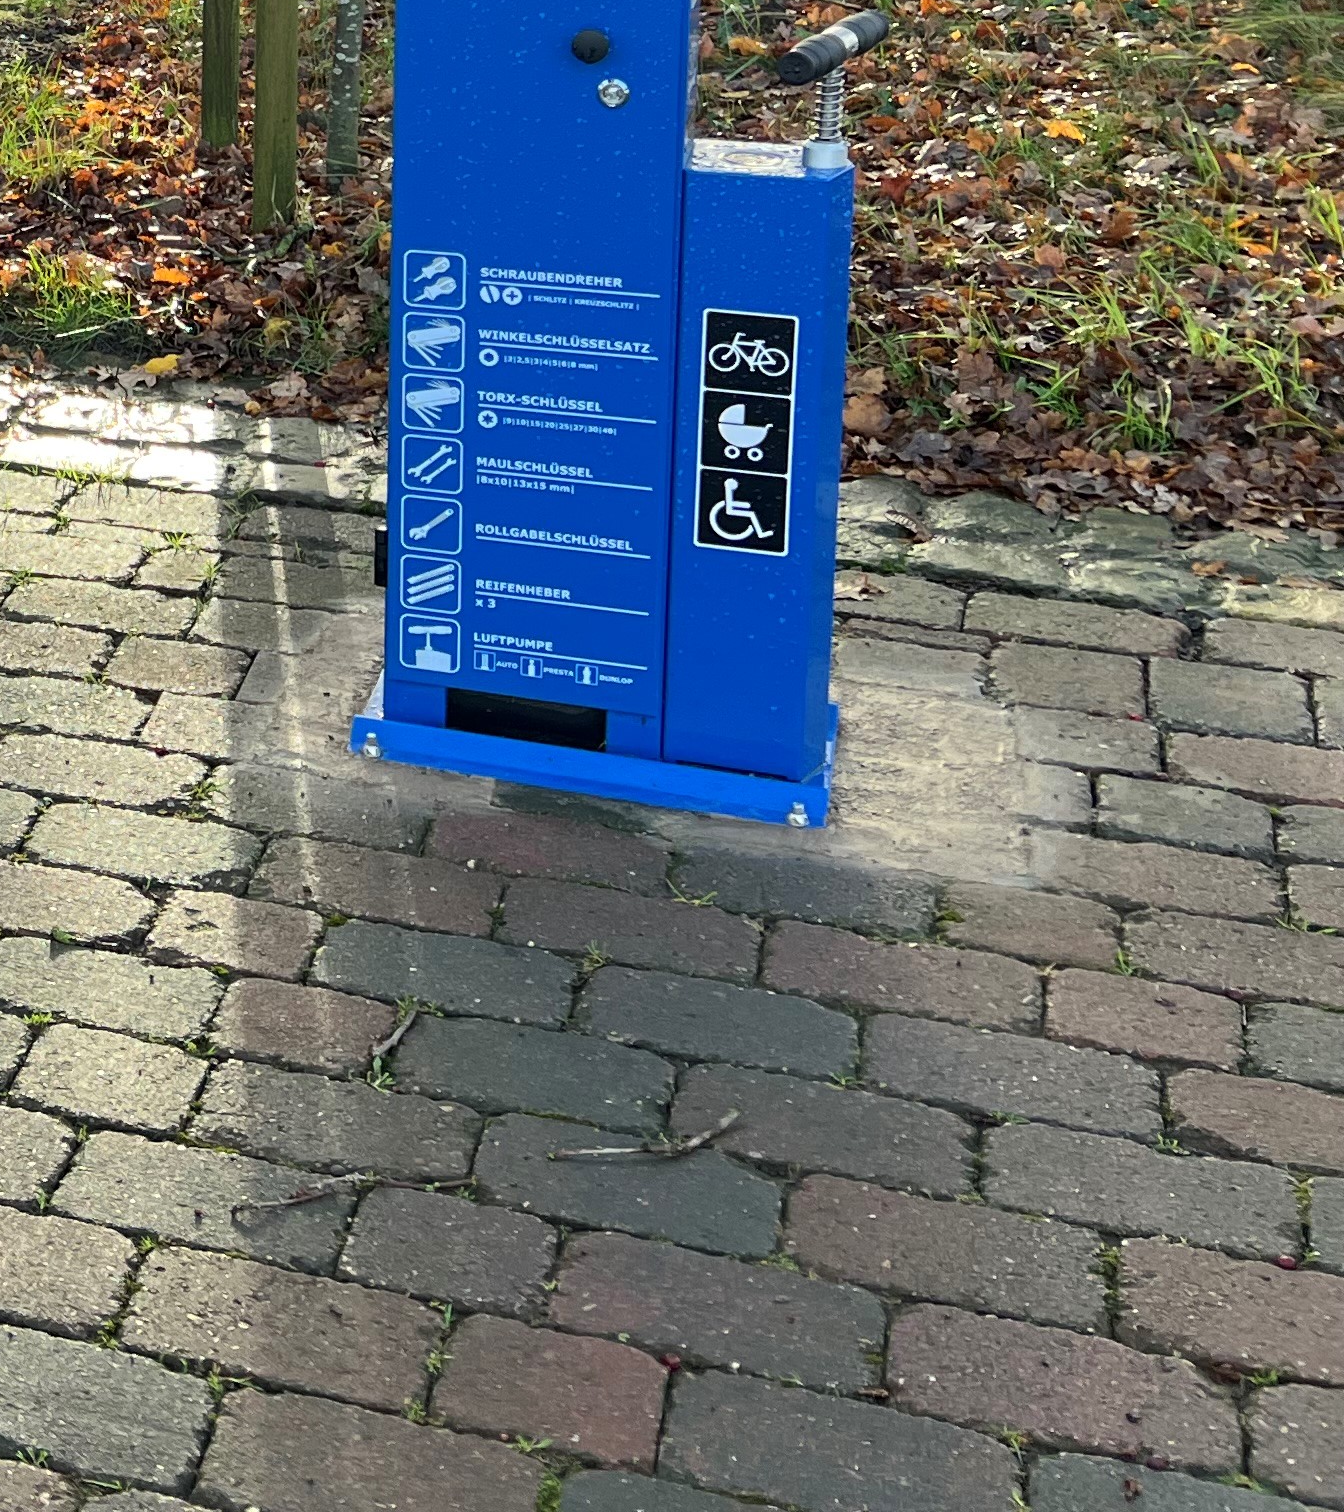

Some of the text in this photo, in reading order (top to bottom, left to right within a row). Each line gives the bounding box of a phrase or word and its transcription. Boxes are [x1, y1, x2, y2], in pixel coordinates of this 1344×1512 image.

[480, 267, 623, 288] SCHRAUBENDREHER
[478, 329, 651, 354] WINKELSCHLÜSSELSATZ
[477, 390, 603, 413] TORX-SCHLÜSSEL
[476, 456, 594, 478] MAULSCHLÜSSEL
[475, 523, 633, 551] ROLLGABELSCHLÜSSEL
[475, 579, 571, 600] REIFENHEBER
[487, 598, 496, 609] 3
[473, 632, 553, 651] LUFTPUMPE
[496, 660, 634, 685] AUTO PRESTA DUNLOP
